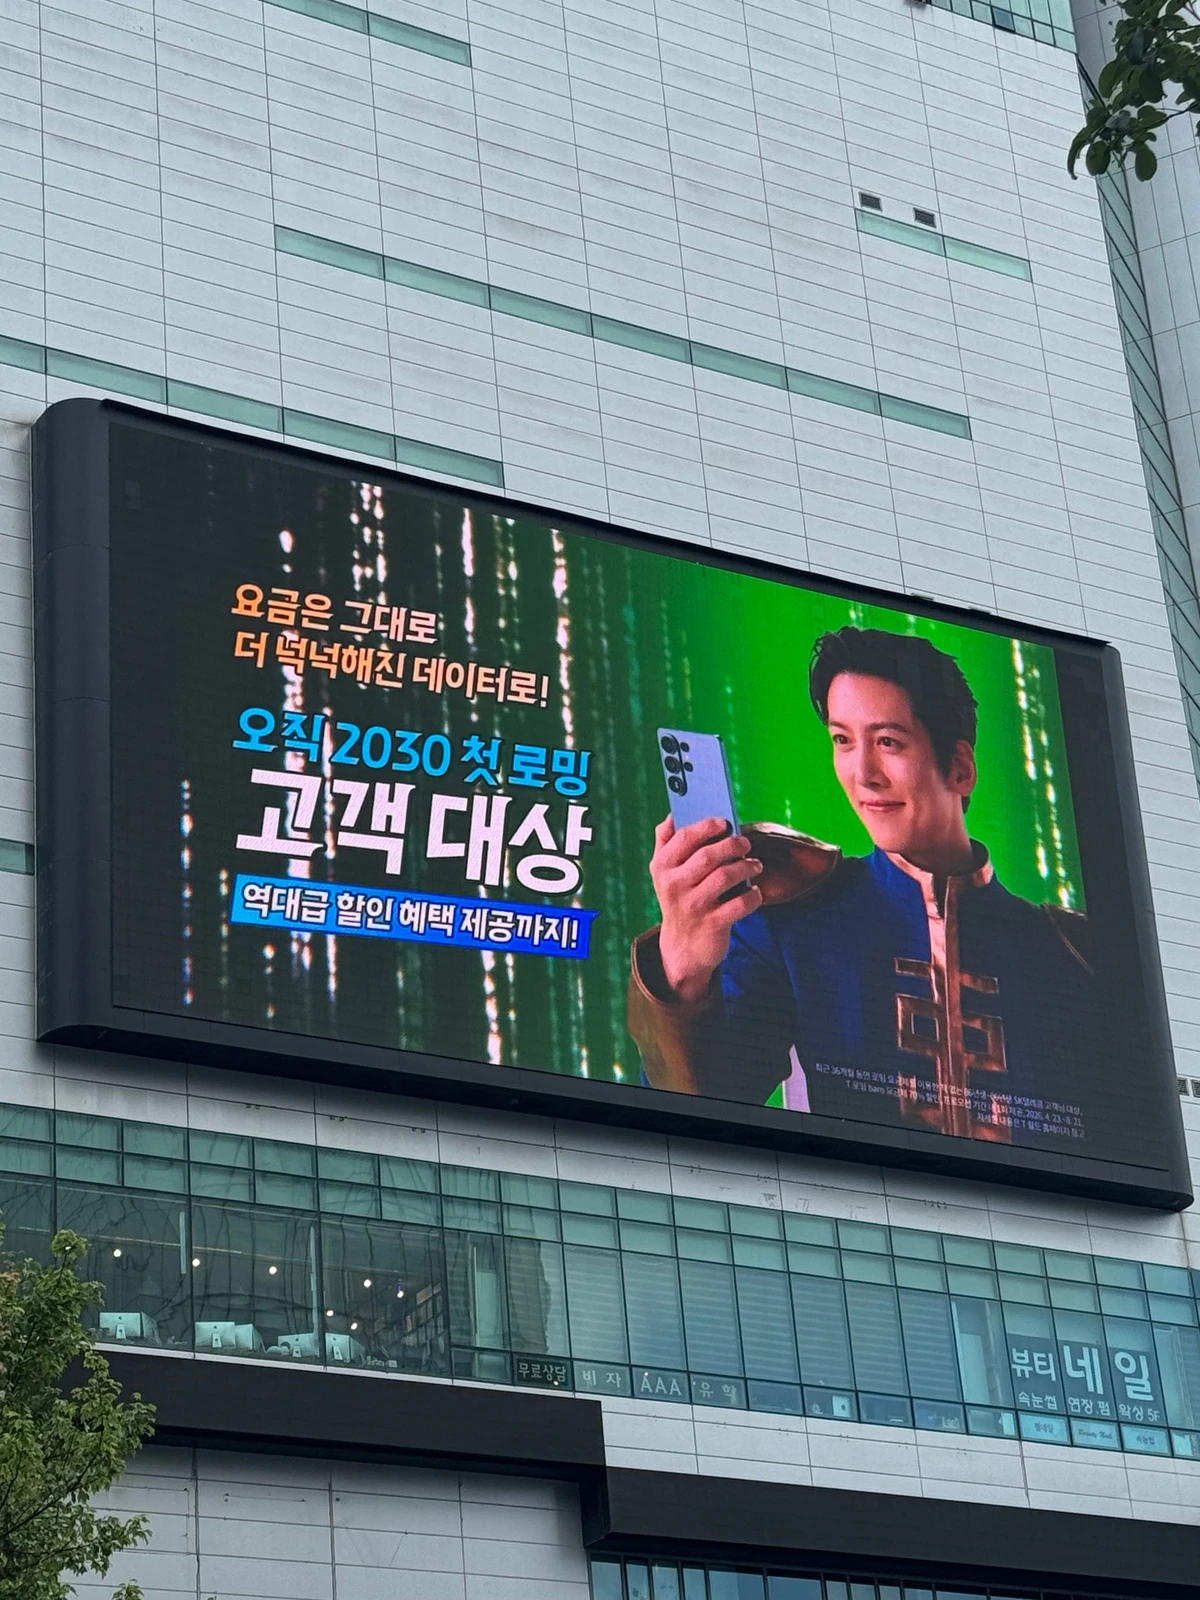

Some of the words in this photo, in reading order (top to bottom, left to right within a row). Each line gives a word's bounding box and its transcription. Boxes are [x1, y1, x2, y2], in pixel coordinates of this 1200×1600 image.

[231, 583, 334, 631] 요금은
[340, 600, 438, 644] 그대로
[233, 631, 269, 668] 더
[275, 636, 405, 689] 넉넉해진
[412, 656, 549, 707] 데이터로!
[232, 707, 325, 762] 오직
[330, 721, 451, 777] 2030
[460, 735, 502, 786] 첫
[508, 744, 592, 797] 로밍
[236, 768, 416, 876] 고객
[426, 794, 593, 894] 대상
[242, 883, 331, 924] 역대급
[336, 893, 393, 931] 할인
[398, 899, 456, 938] 혜택
[460, 907, 579, 949] 제공까지!
[518, 1362, 567, 1384] 무료상담
[640, 1376, 682, 1396] AAA
[1011, 1347, 1056, 1382] 뷰티
[1063, 1345, 1154, 1401] 네일
[1018, 1390, 1058, 1411] 속눈썹
[1118, 1403, 1144, 1422] 왁싱
[1147, 1408, 1160, 1422] 5F
